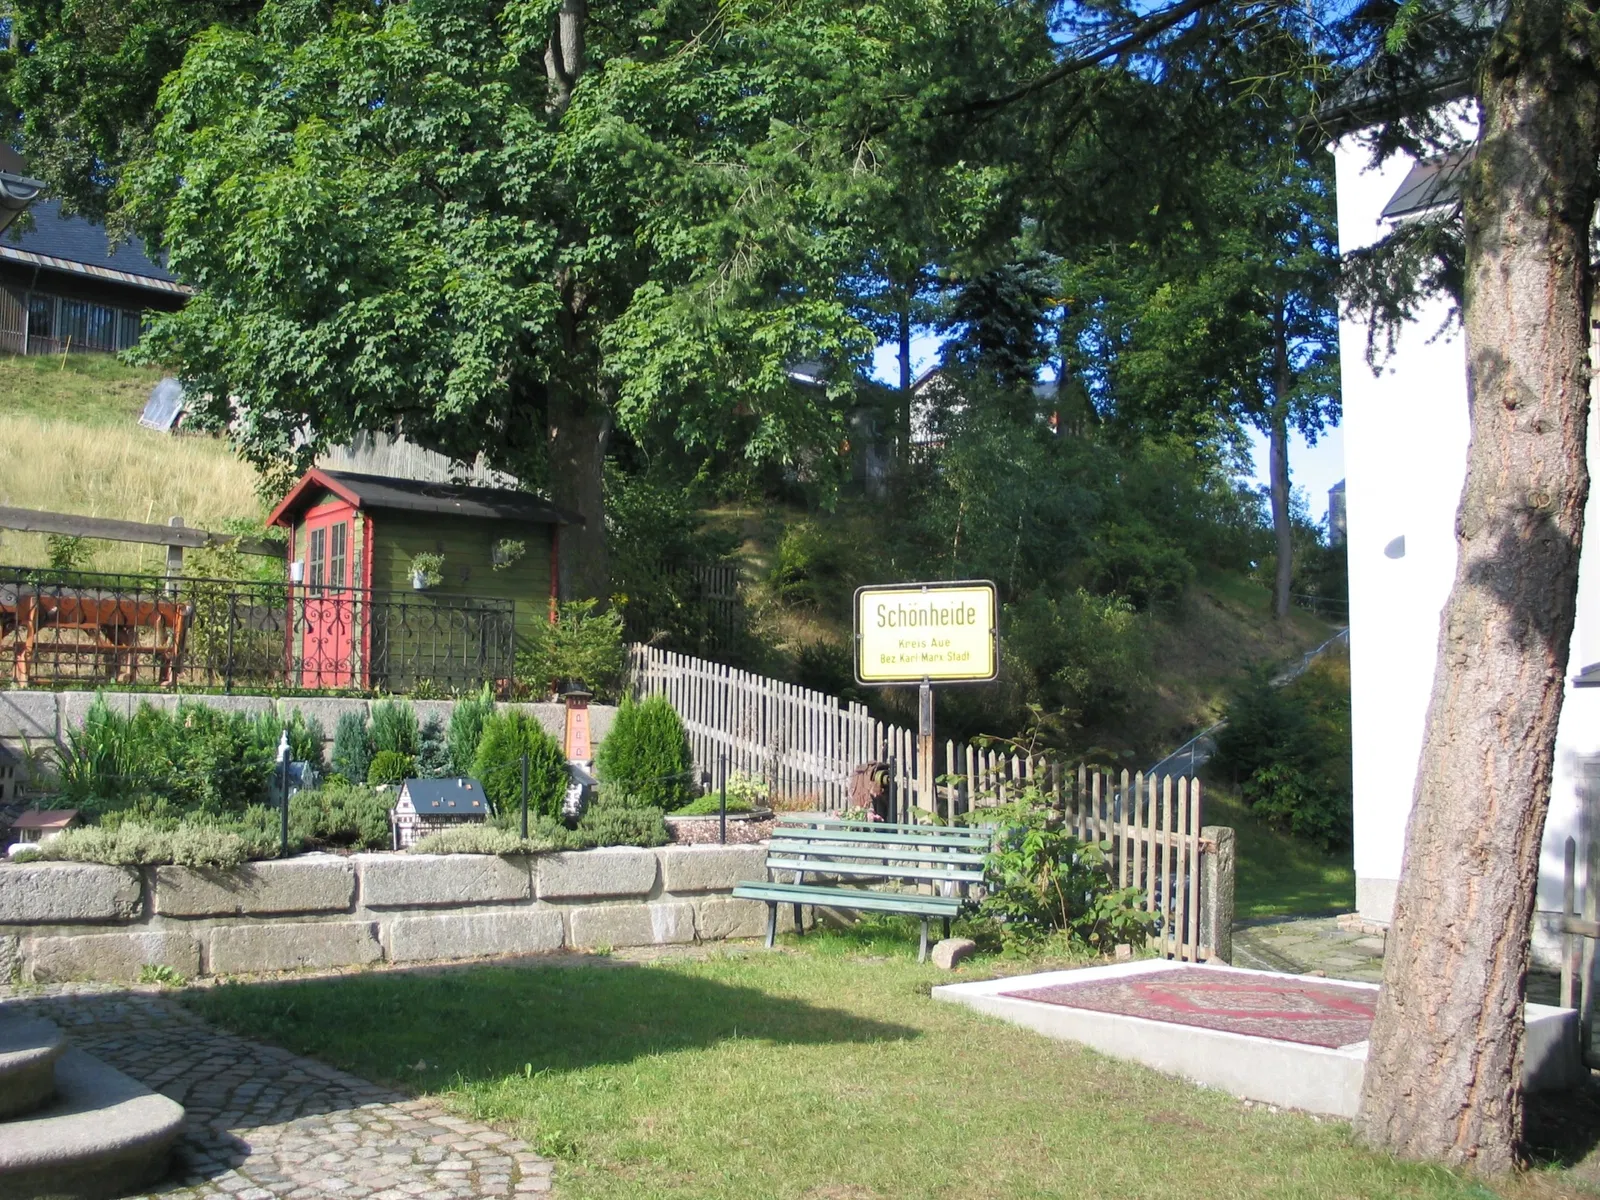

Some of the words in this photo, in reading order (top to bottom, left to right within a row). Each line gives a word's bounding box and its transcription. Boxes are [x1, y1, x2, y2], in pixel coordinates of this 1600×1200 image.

[877, 600, 976, 628] Schönheide
[898, 639, 927, 649] Kreis
[930, 637, 951, 648] Aue
